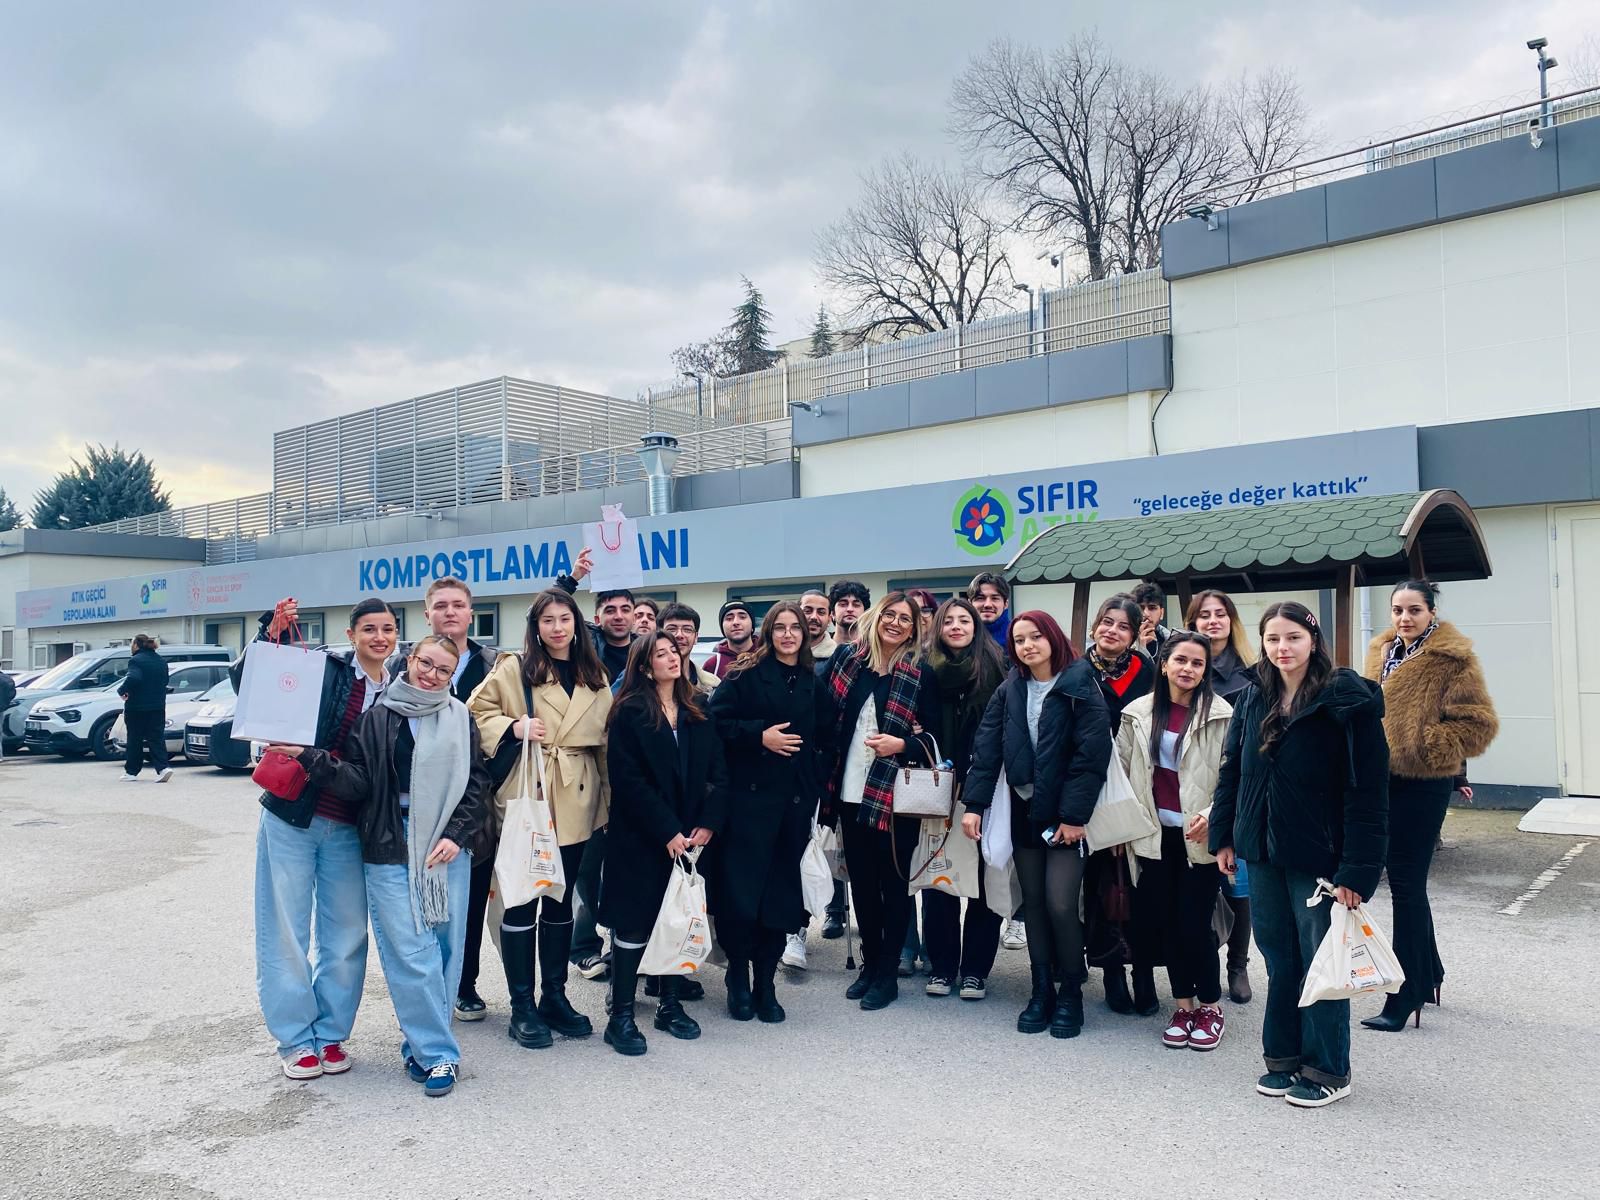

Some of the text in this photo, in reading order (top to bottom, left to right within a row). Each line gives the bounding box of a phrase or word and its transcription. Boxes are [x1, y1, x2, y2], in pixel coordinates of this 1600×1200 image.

[1017, 480, 1098, 514] SIFIR
[1229, 485, 1286, 506] değer
[359, 541, 574, 591] KOMPOSTLAMA
[71, 591, 84, 603] ATIK
[63, 608, 95, 621] DEPOLAMA
[97, 605, 116, 617] ALANI
